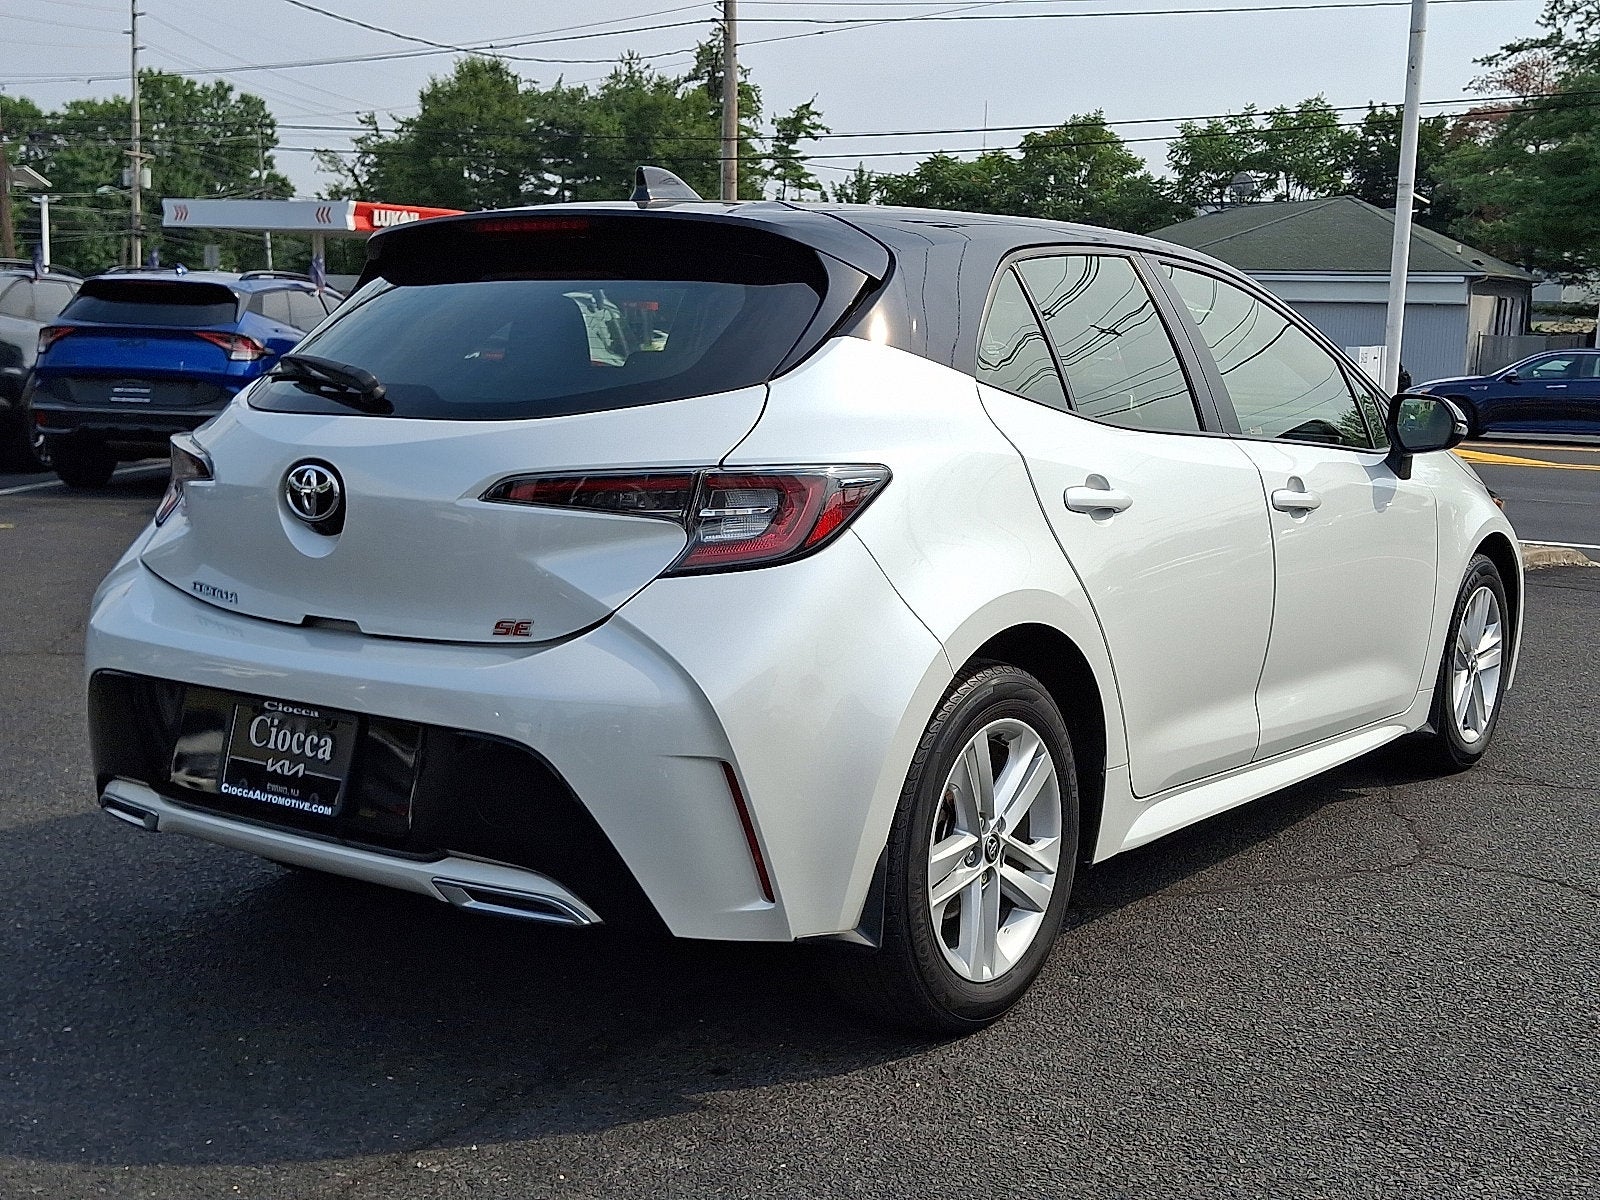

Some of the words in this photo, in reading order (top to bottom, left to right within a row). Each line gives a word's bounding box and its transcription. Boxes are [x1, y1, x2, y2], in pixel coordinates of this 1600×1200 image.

[492, 618, 535, 637] SE
[263, 700, 320, 718] Ciocca
[249, 715, 333, 761] Ciocca
